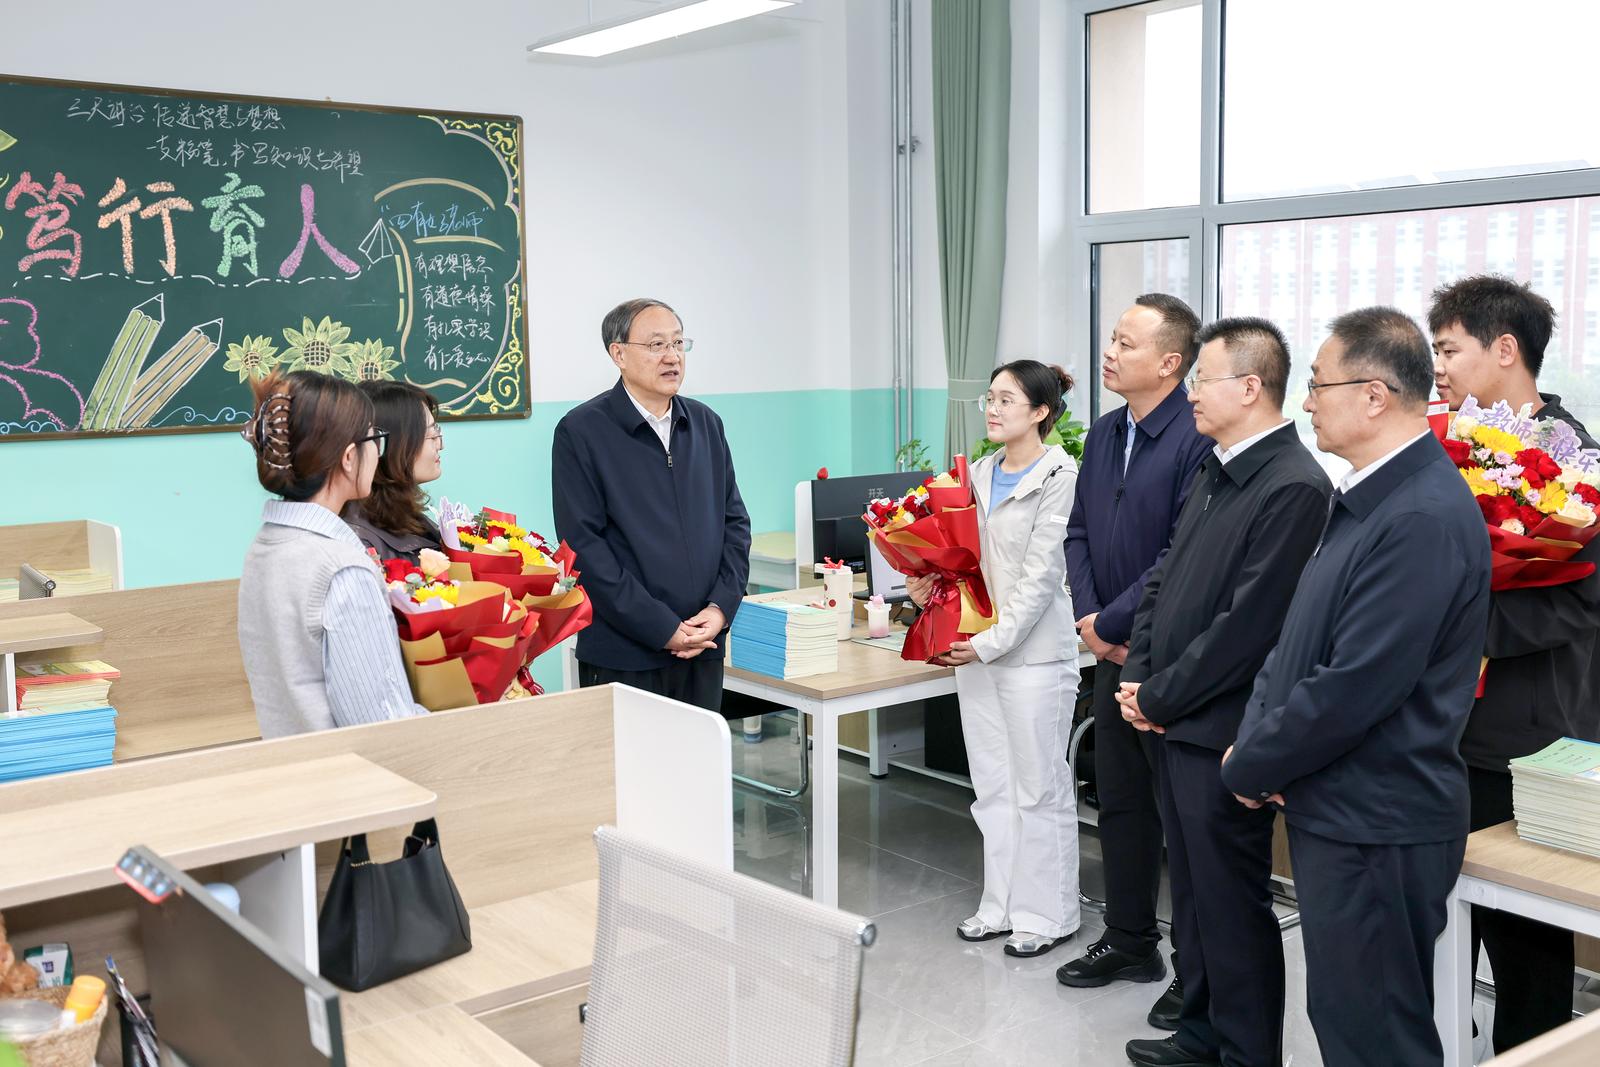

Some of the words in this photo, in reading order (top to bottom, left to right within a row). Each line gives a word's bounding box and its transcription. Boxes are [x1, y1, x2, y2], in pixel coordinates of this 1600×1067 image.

[5, 171, 361, 278] 笃行育人
[414, 252, 494, 281] 有理想信念
[420, 283, 496, 316] 有道德情操
[424, 314, 494, 341] 有扎实学识
[424, 344, 491, 371] 有仁爱之心
